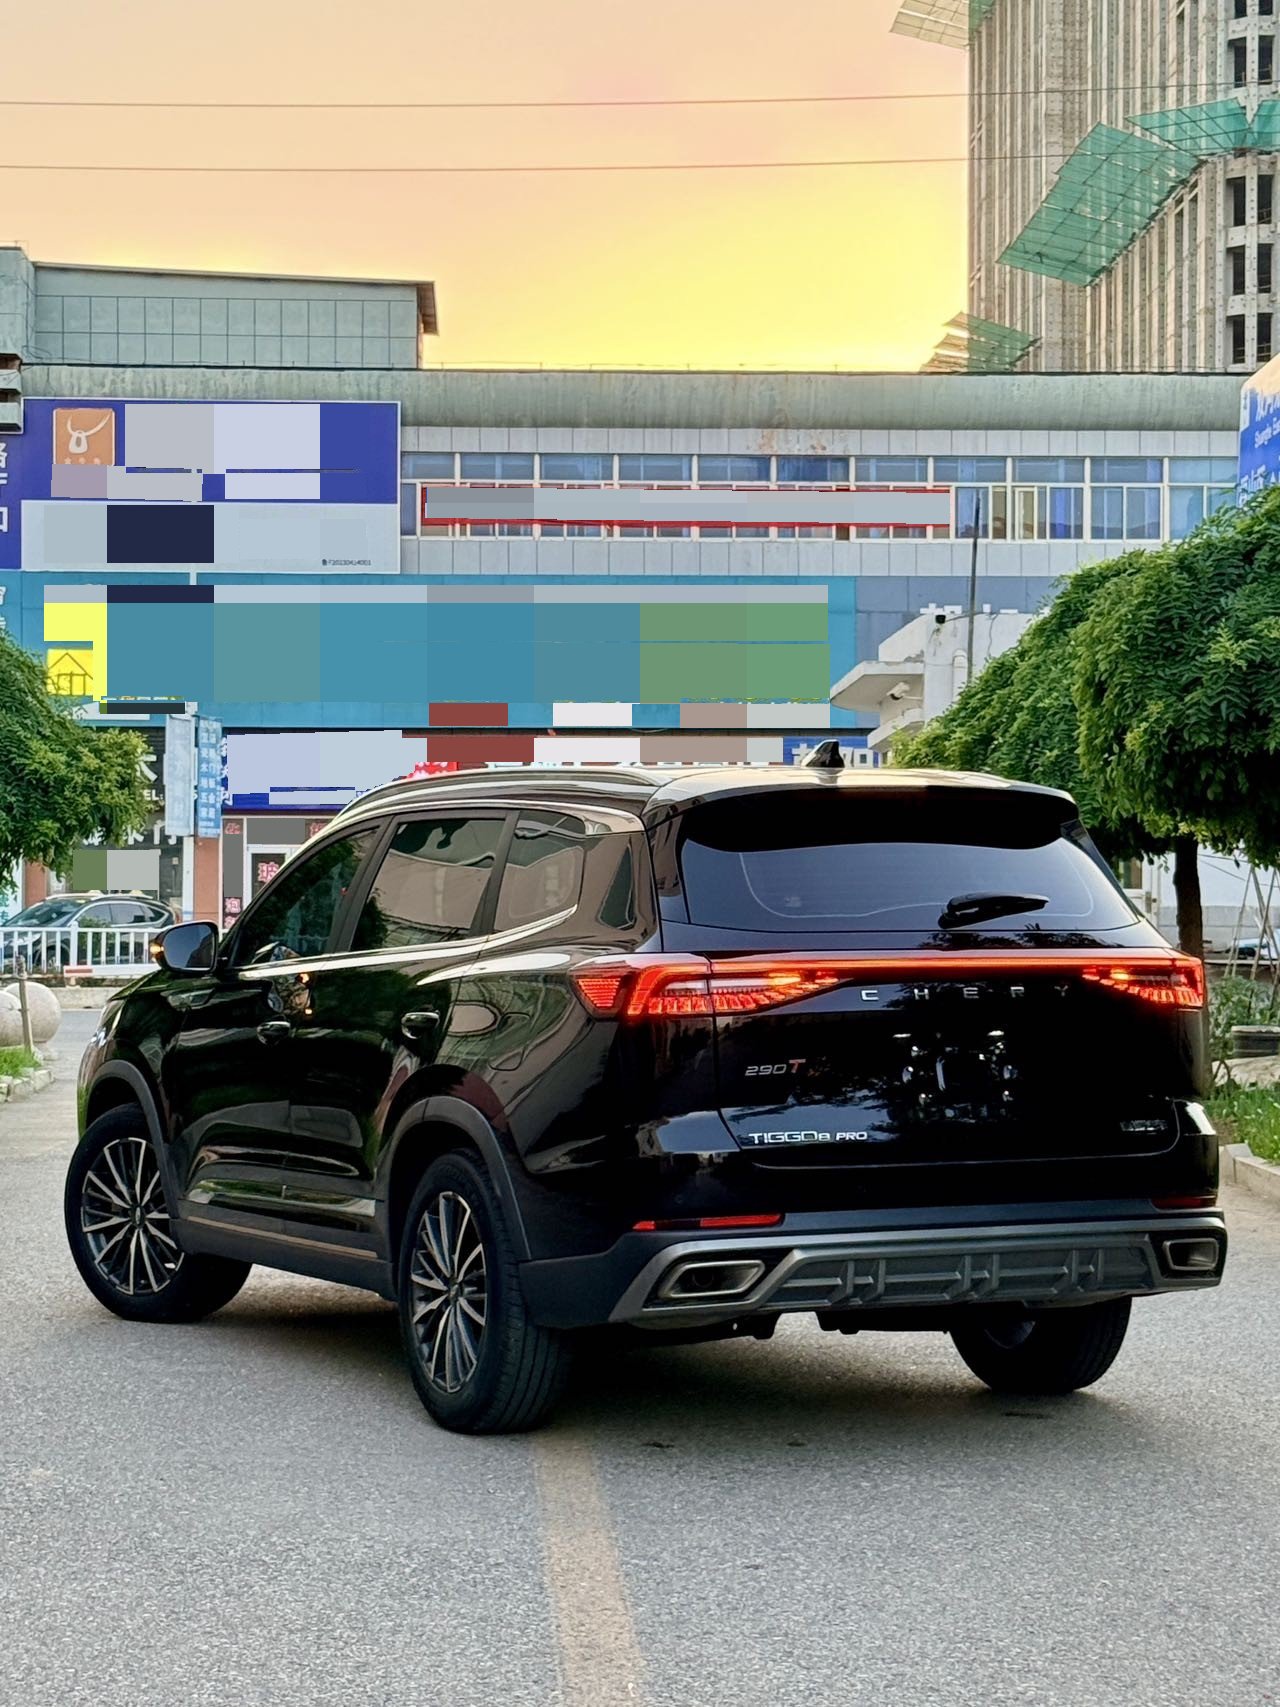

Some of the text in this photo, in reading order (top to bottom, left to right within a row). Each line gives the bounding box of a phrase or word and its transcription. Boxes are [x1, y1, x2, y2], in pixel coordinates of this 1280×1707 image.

[861, 984, 1069, 1001] CHERY
[744, 1058, 806, 1077] 290T
[835, 1131, 868, 1141] PRO
